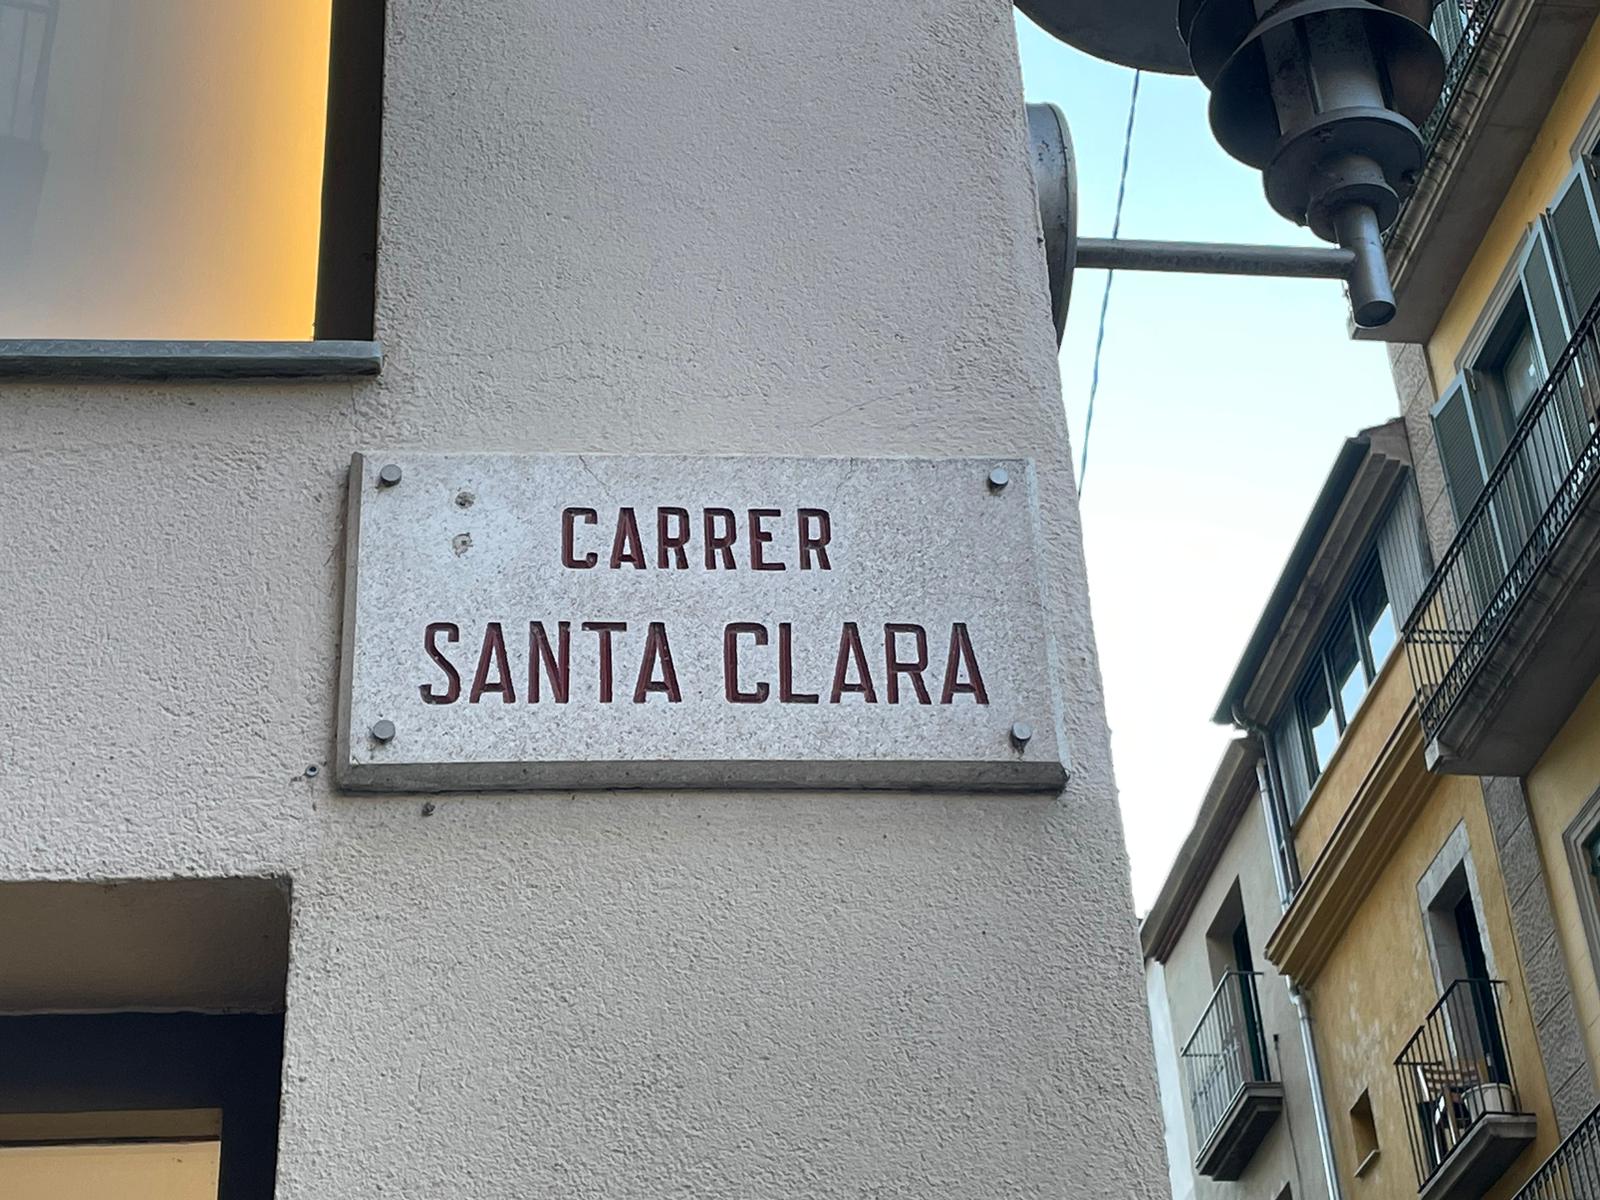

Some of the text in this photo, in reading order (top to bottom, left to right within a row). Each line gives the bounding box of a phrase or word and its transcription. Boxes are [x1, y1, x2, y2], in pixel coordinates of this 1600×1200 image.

[561, 507, 832, 571] CARRER
[419, 621, 990, 706] SANTA CLARA
